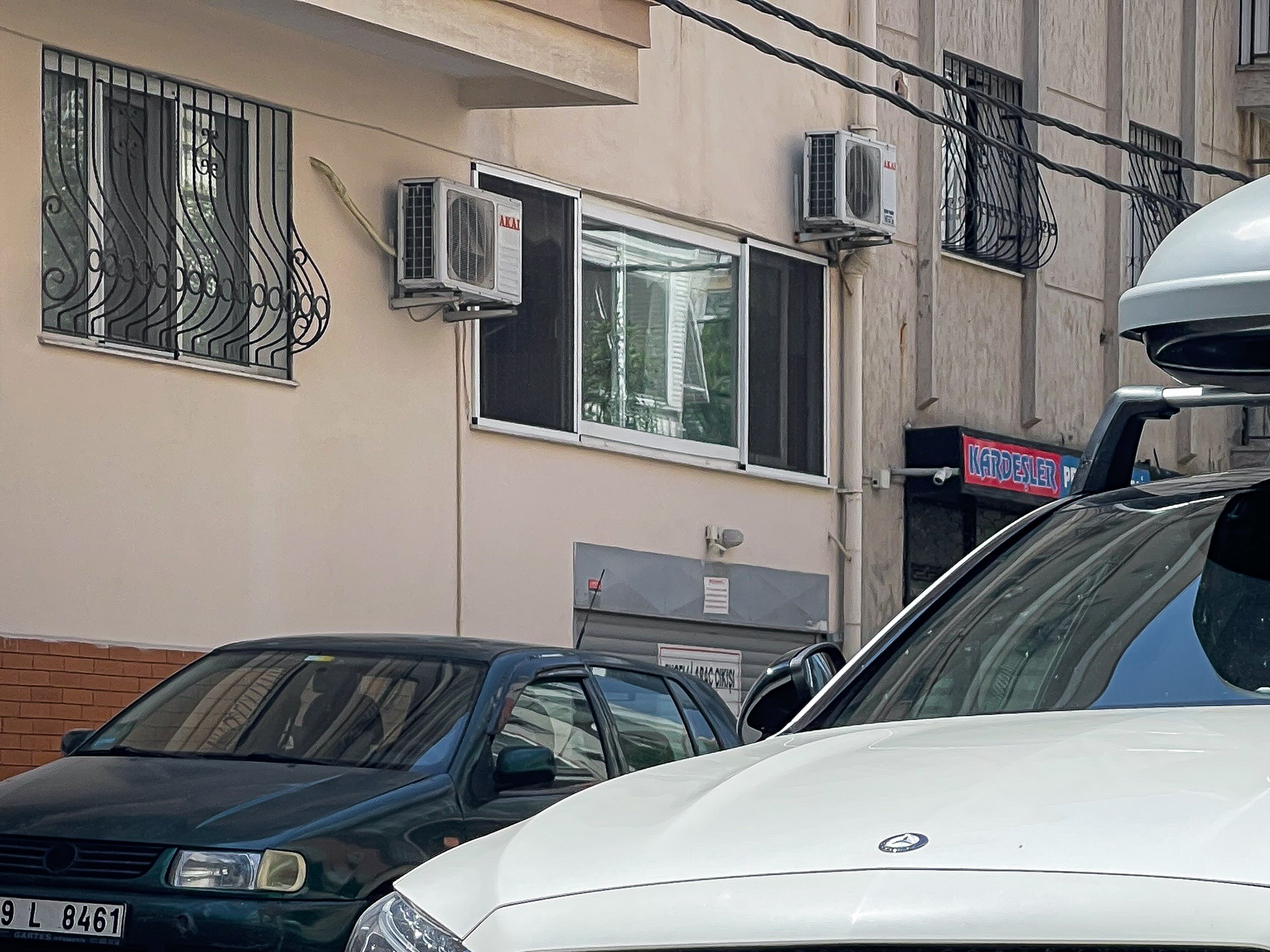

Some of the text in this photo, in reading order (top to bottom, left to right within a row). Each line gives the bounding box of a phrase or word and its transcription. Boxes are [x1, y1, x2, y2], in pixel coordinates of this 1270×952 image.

[500, 215, 520, 231] AKAI
[968, 444, 1058, 493] KARDEŞLER
[28, 902, 41, 928] L
[62, 904, 120, 934] 8461
